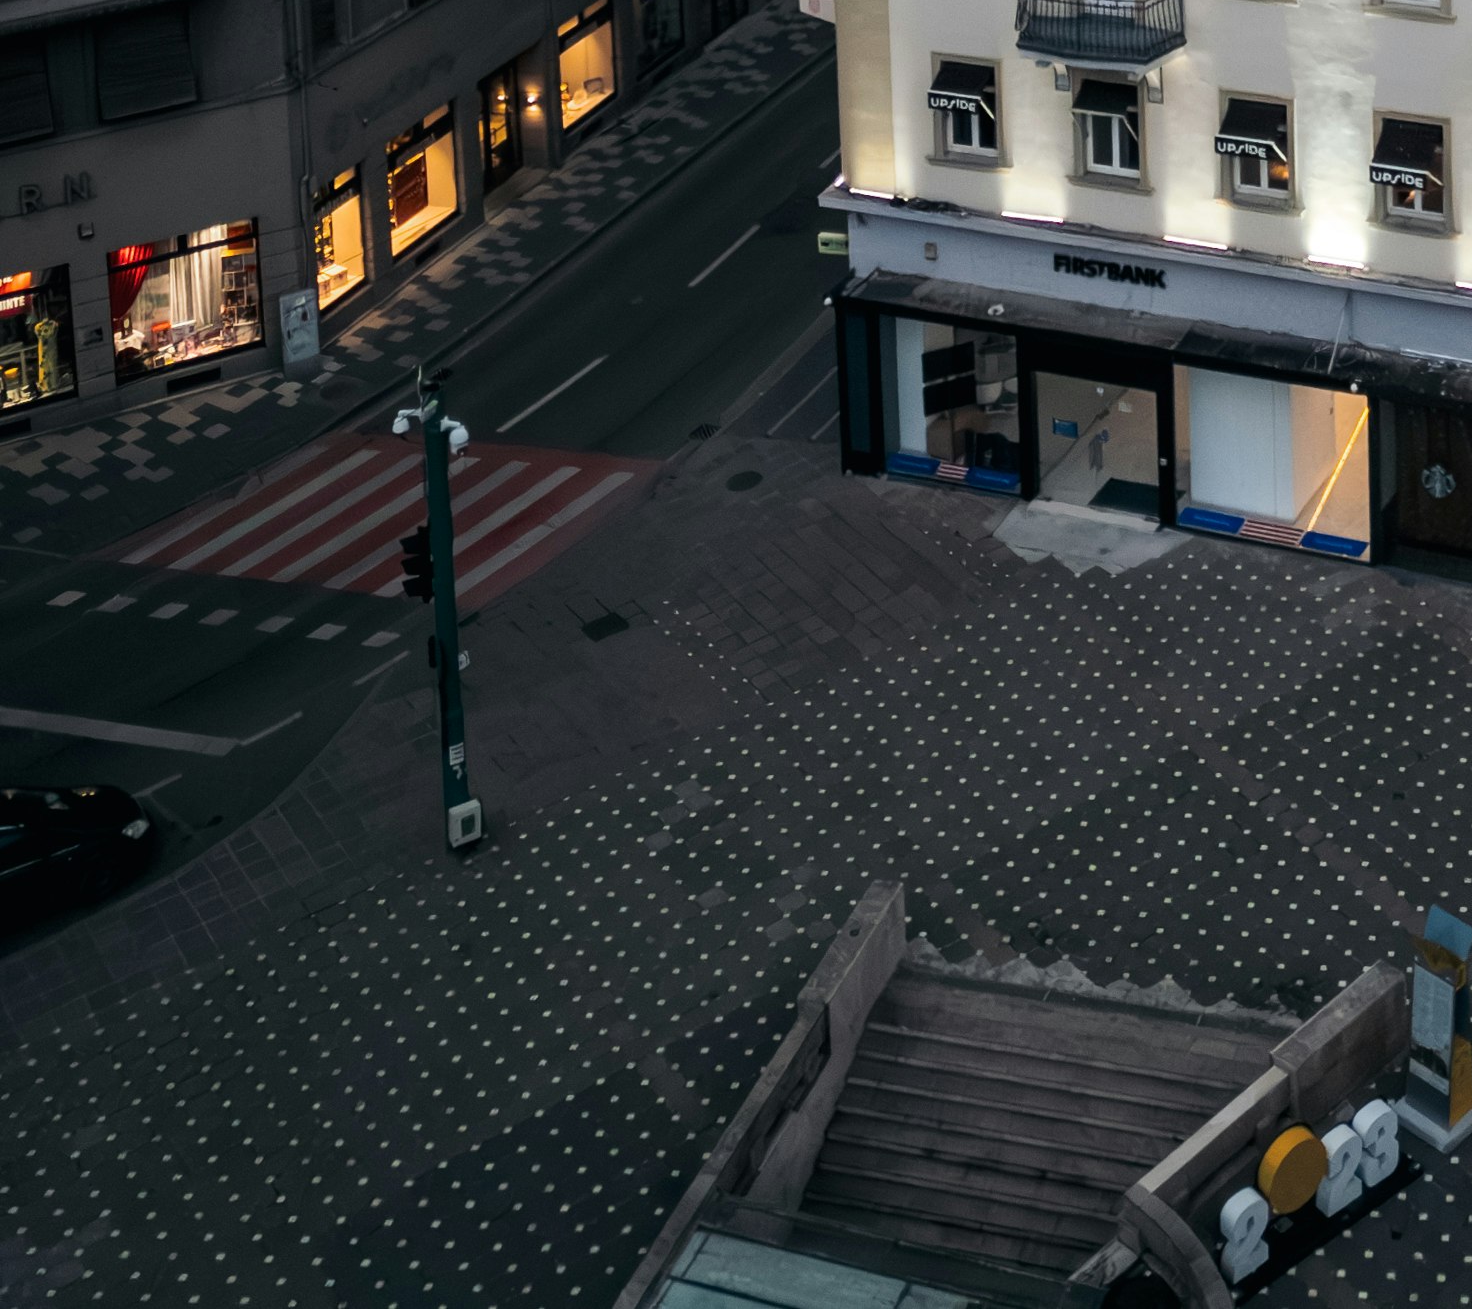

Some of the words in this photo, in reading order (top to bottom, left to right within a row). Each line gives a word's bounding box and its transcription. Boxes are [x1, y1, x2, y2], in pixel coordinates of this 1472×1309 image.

[930, 97, 976, 113] UPSIDE
[1217, 141, 1267, 159] UPSIDE
[1372, 170, 1424, 189] UPSIDE
[1053, 253, 1166, 289] FIRSTBANK
